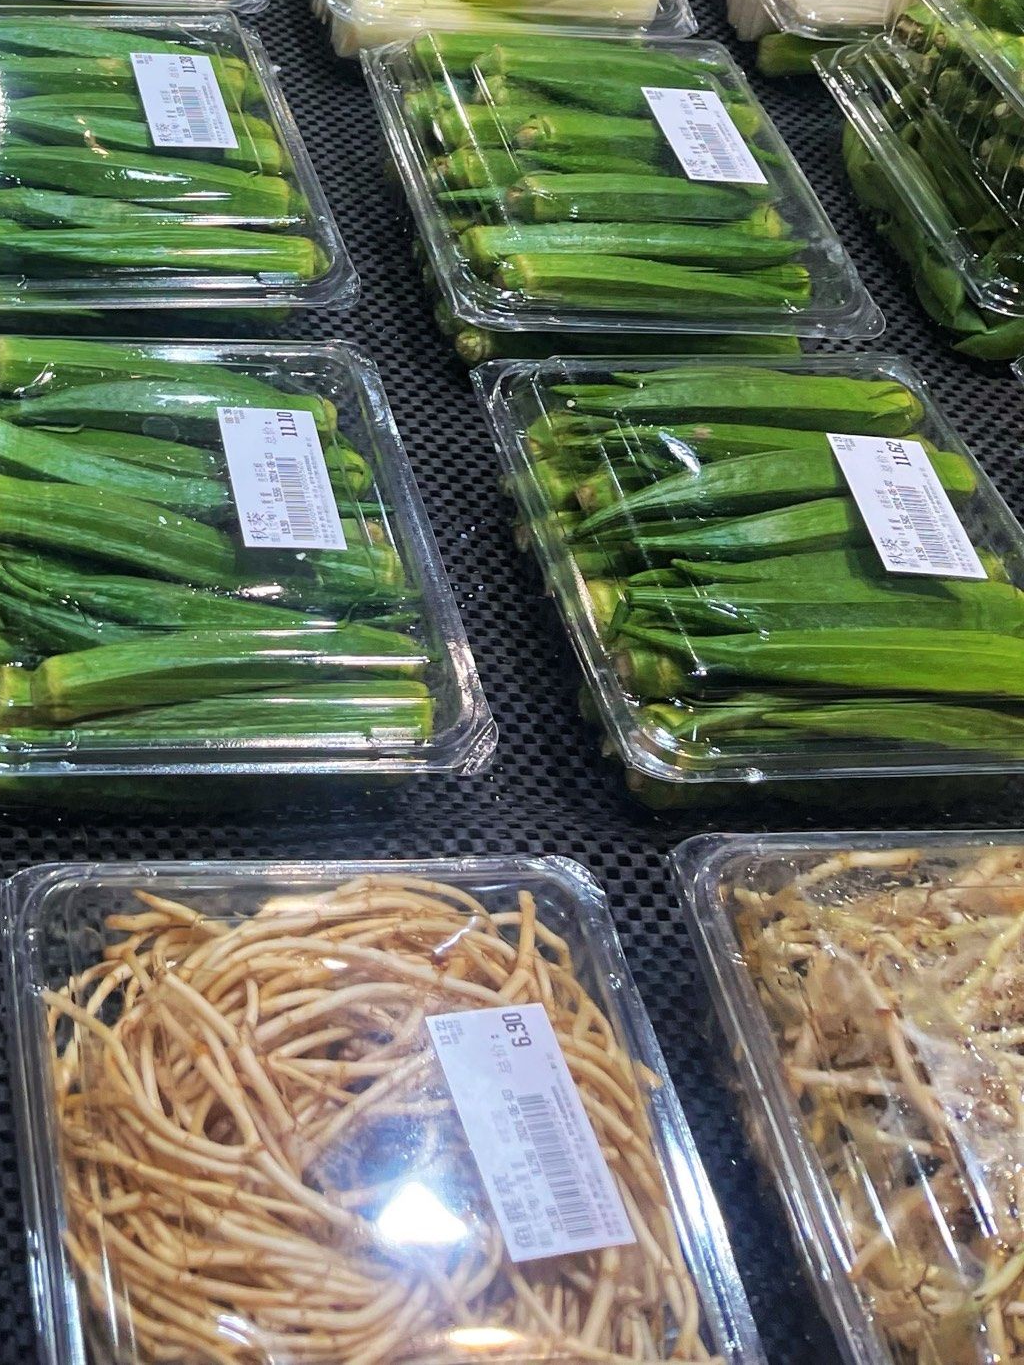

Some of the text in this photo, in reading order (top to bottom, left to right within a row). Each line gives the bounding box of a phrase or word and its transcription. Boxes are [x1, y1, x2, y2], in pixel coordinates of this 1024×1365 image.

[276, 411, 297, 436] 11.10
[885, 441, 912, 466] 11.62
[245, 511, 270, 540] 秋葵
[878, 537, 908, 565] 秋葵
[500, 1011, 532, 1046] 6.90
